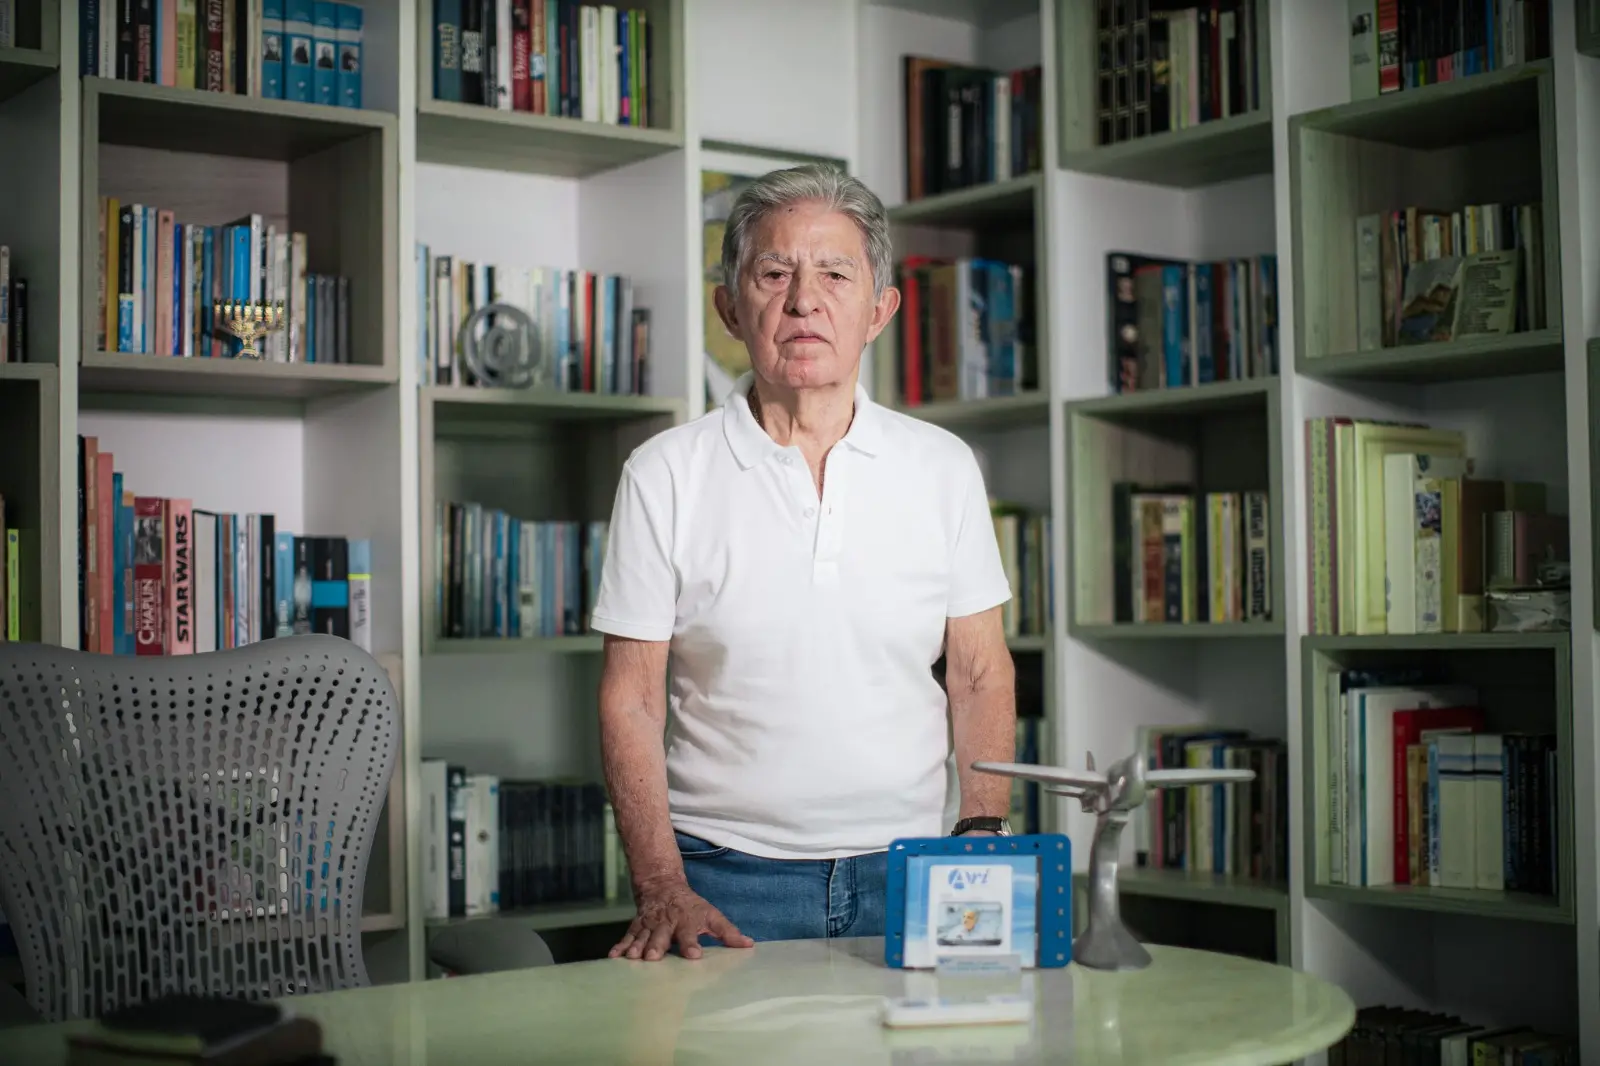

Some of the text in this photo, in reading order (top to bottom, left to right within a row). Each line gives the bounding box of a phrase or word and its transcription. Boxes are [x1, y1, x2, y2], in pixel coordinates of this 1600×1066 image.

[138, 579, 155, 645] CHAPLIN
[176, 514, 189, 642] STAR WARS
